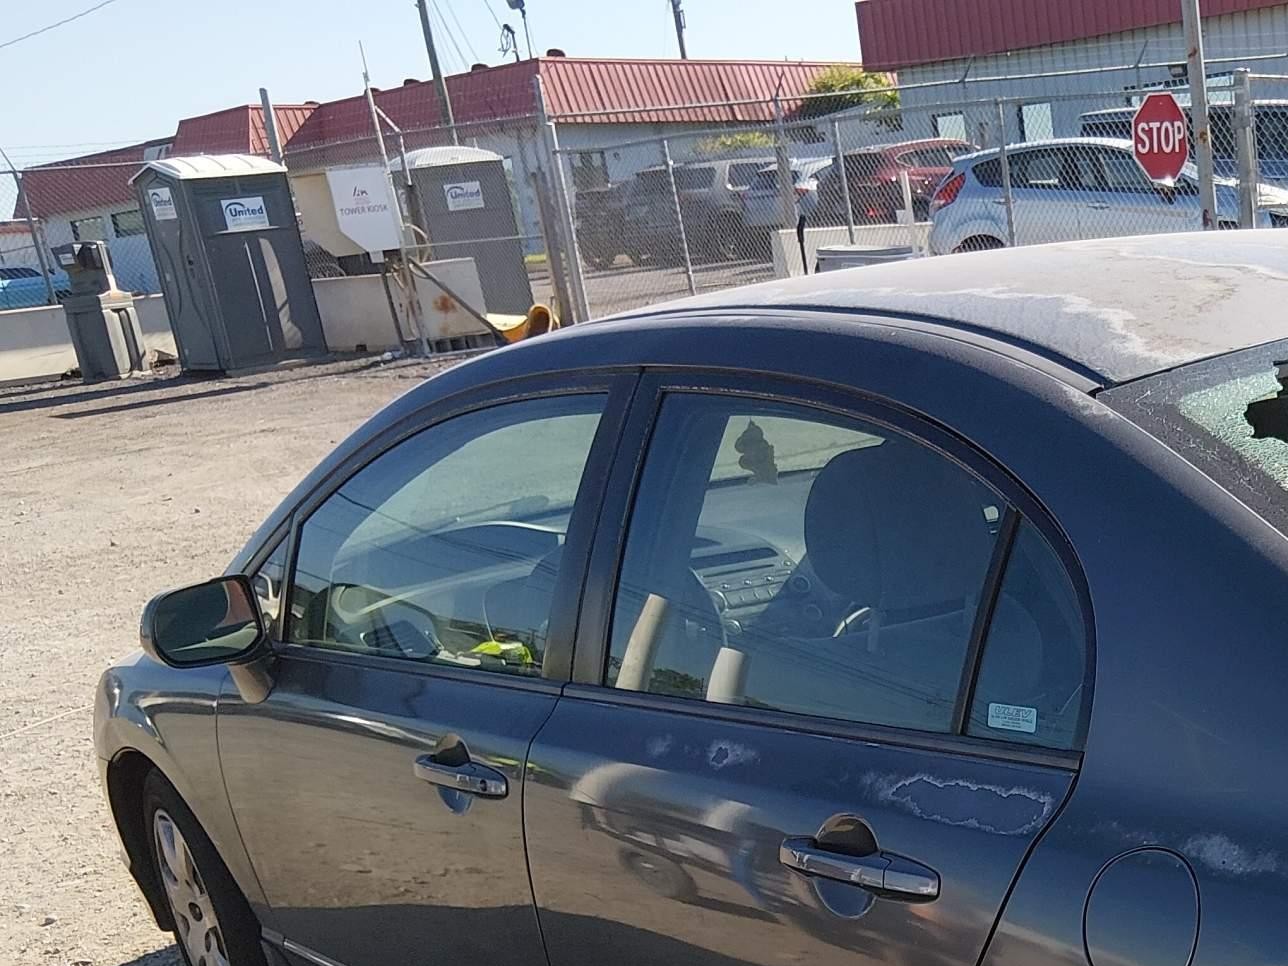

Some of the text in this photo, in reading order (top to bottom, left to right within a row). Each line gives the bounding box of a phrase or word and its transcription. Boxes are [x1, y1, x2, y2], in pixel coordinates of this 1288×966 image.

[1137, 120, 1185, 154] STOP
[450, 188, 481, 200] United
[228, 206, 264, 218] United
[340, 203, 387, 216] TOWER KIOSK
